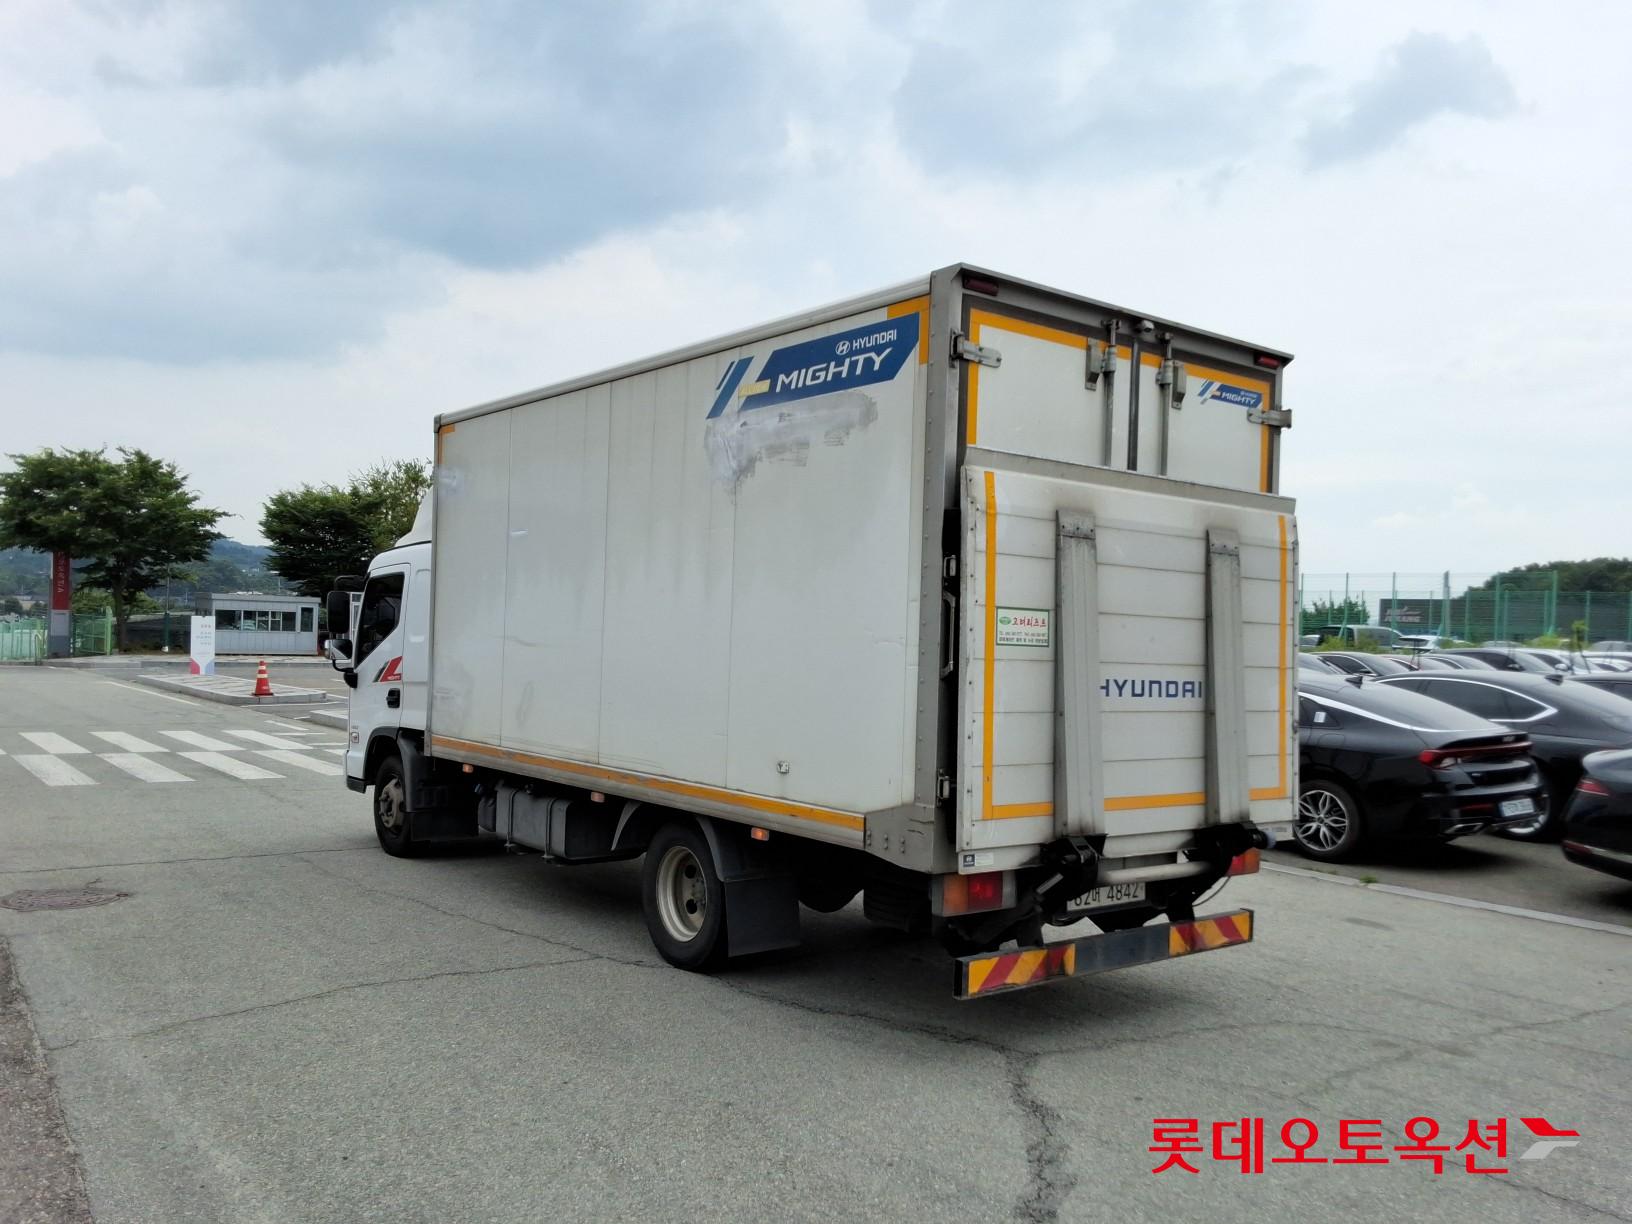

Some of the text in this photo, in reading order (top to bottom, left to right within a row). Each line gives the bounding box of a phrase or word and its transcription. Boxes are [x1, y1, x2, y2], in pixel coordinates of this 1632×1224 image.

[852, 328, 897, 350] HYUNDAI
[775, 347, 894, 393] MIGHTY
[1221, 391, 1257, 405] MIGHTY
[1107, 883, 1138, 901] 4842
